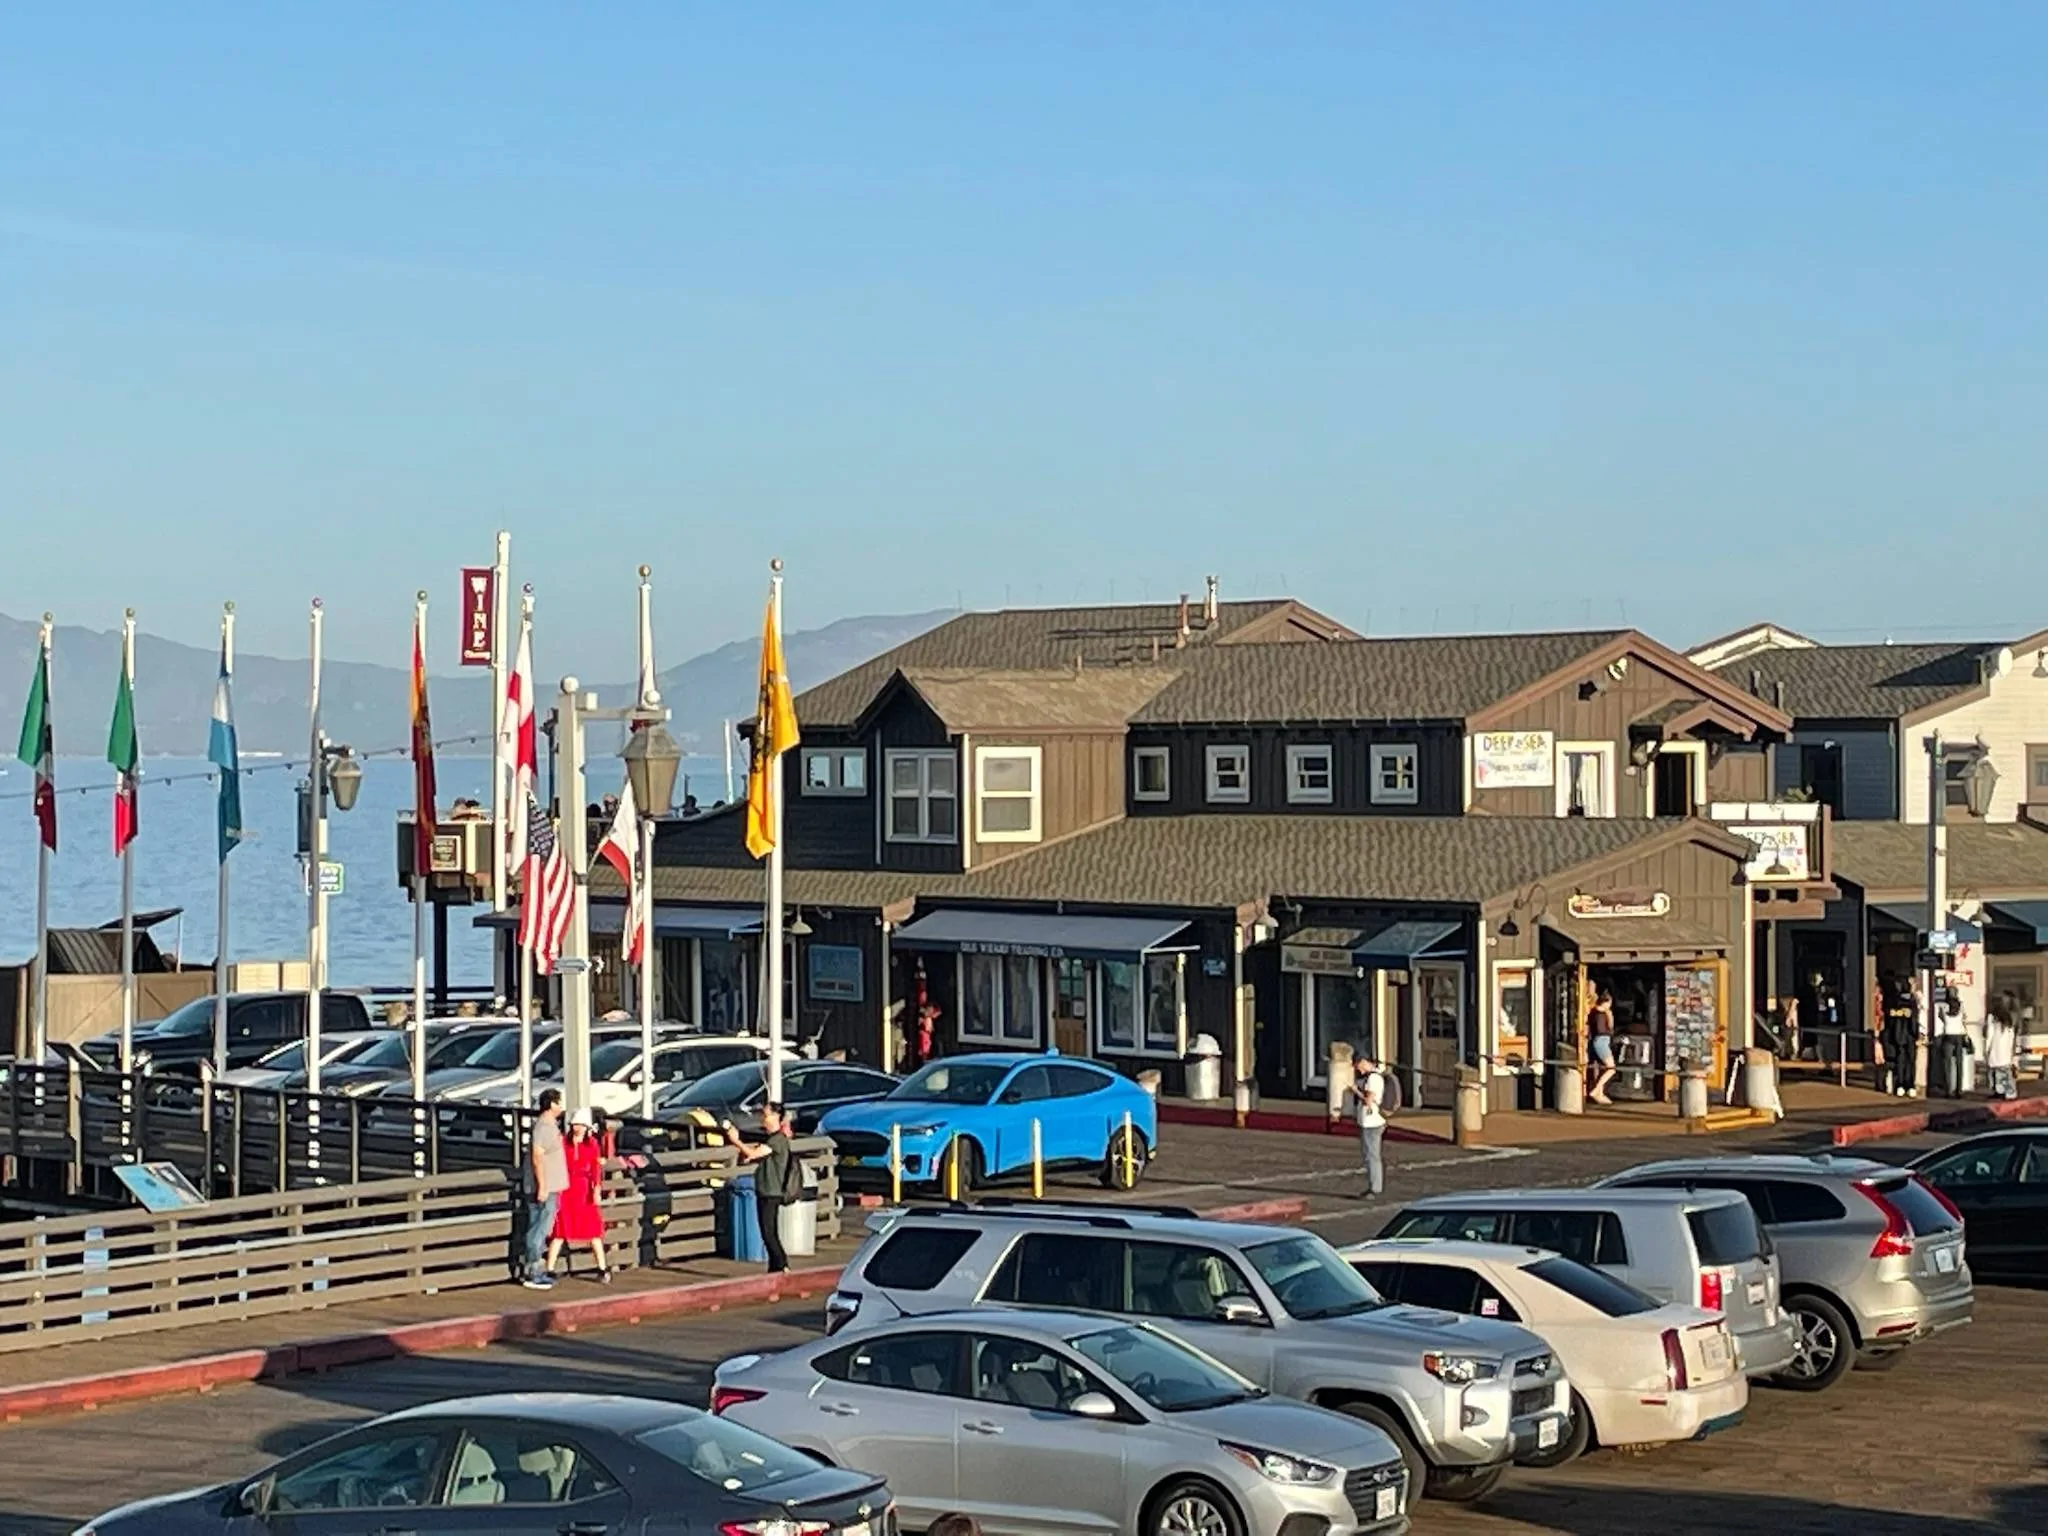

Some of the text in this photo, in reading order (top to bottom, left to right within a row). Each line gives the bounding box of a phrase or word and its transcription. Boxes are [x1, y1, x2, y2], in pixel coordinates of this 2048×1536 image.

[470, 576, 488, 648] WINE
[1483, 733, 1547, 751] DEEP SEA
